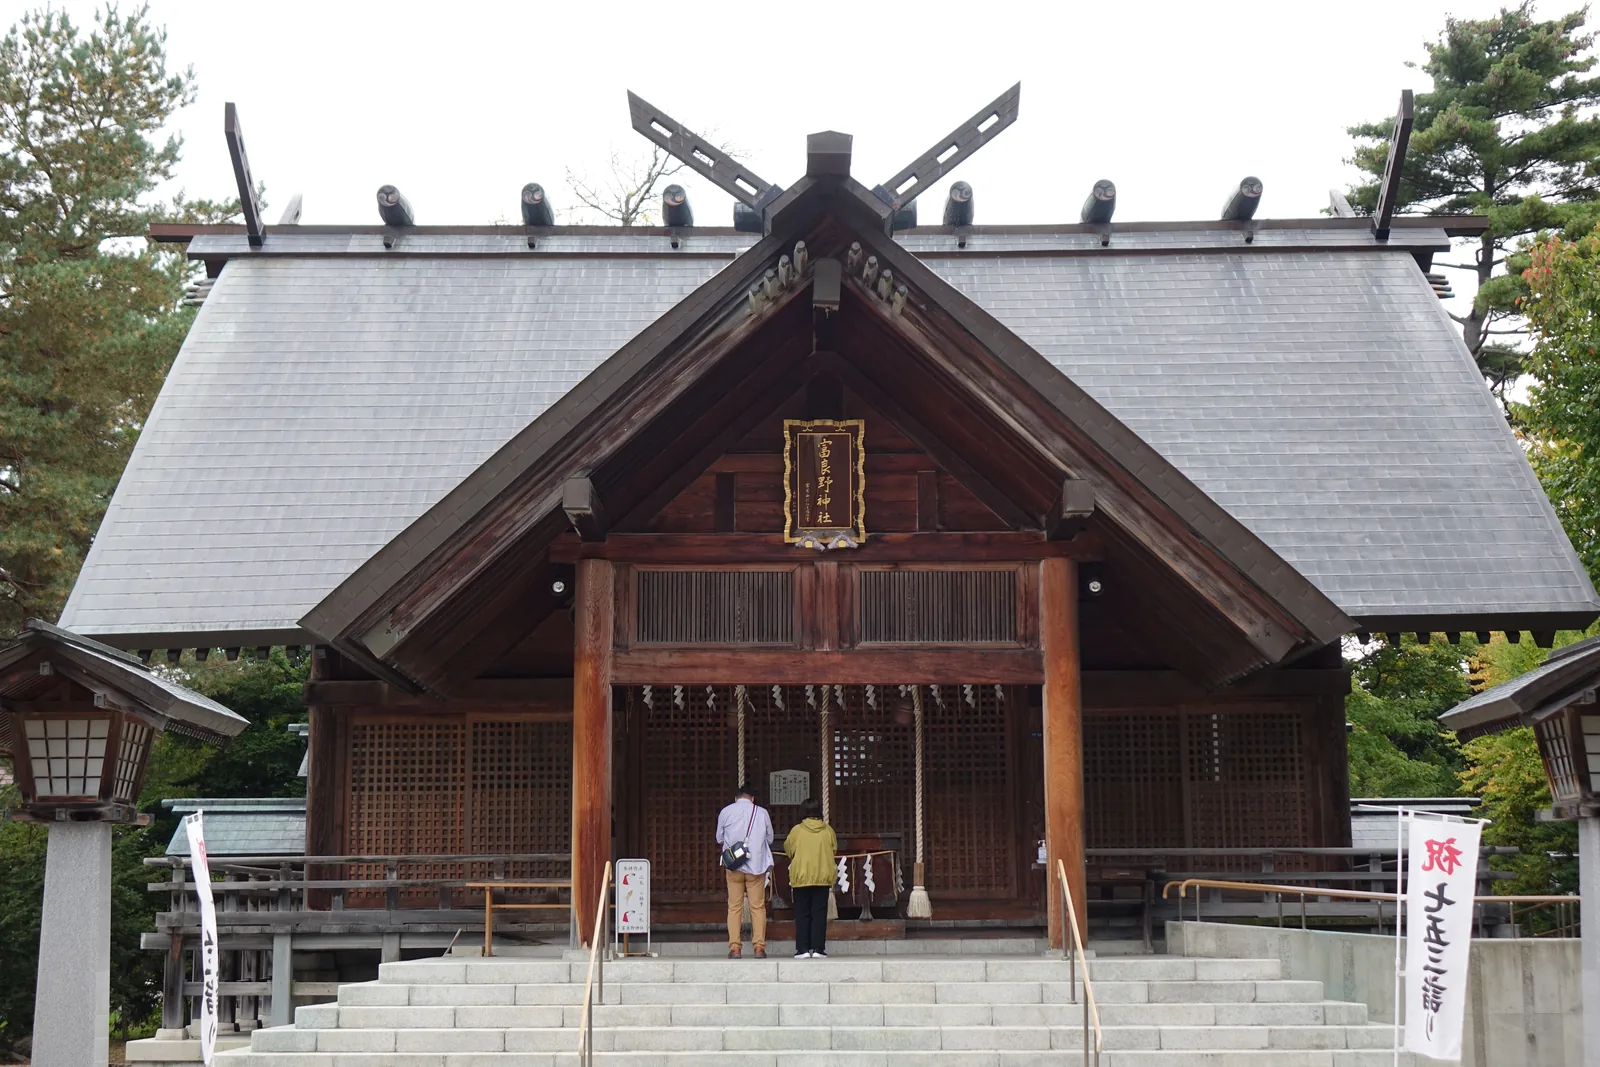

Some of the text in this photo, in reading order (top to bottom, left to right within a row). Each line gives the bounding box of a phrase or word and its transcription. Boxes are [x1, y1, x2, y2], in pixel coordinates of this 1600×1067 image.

[817, 438, 833, 524] 富良野神社
